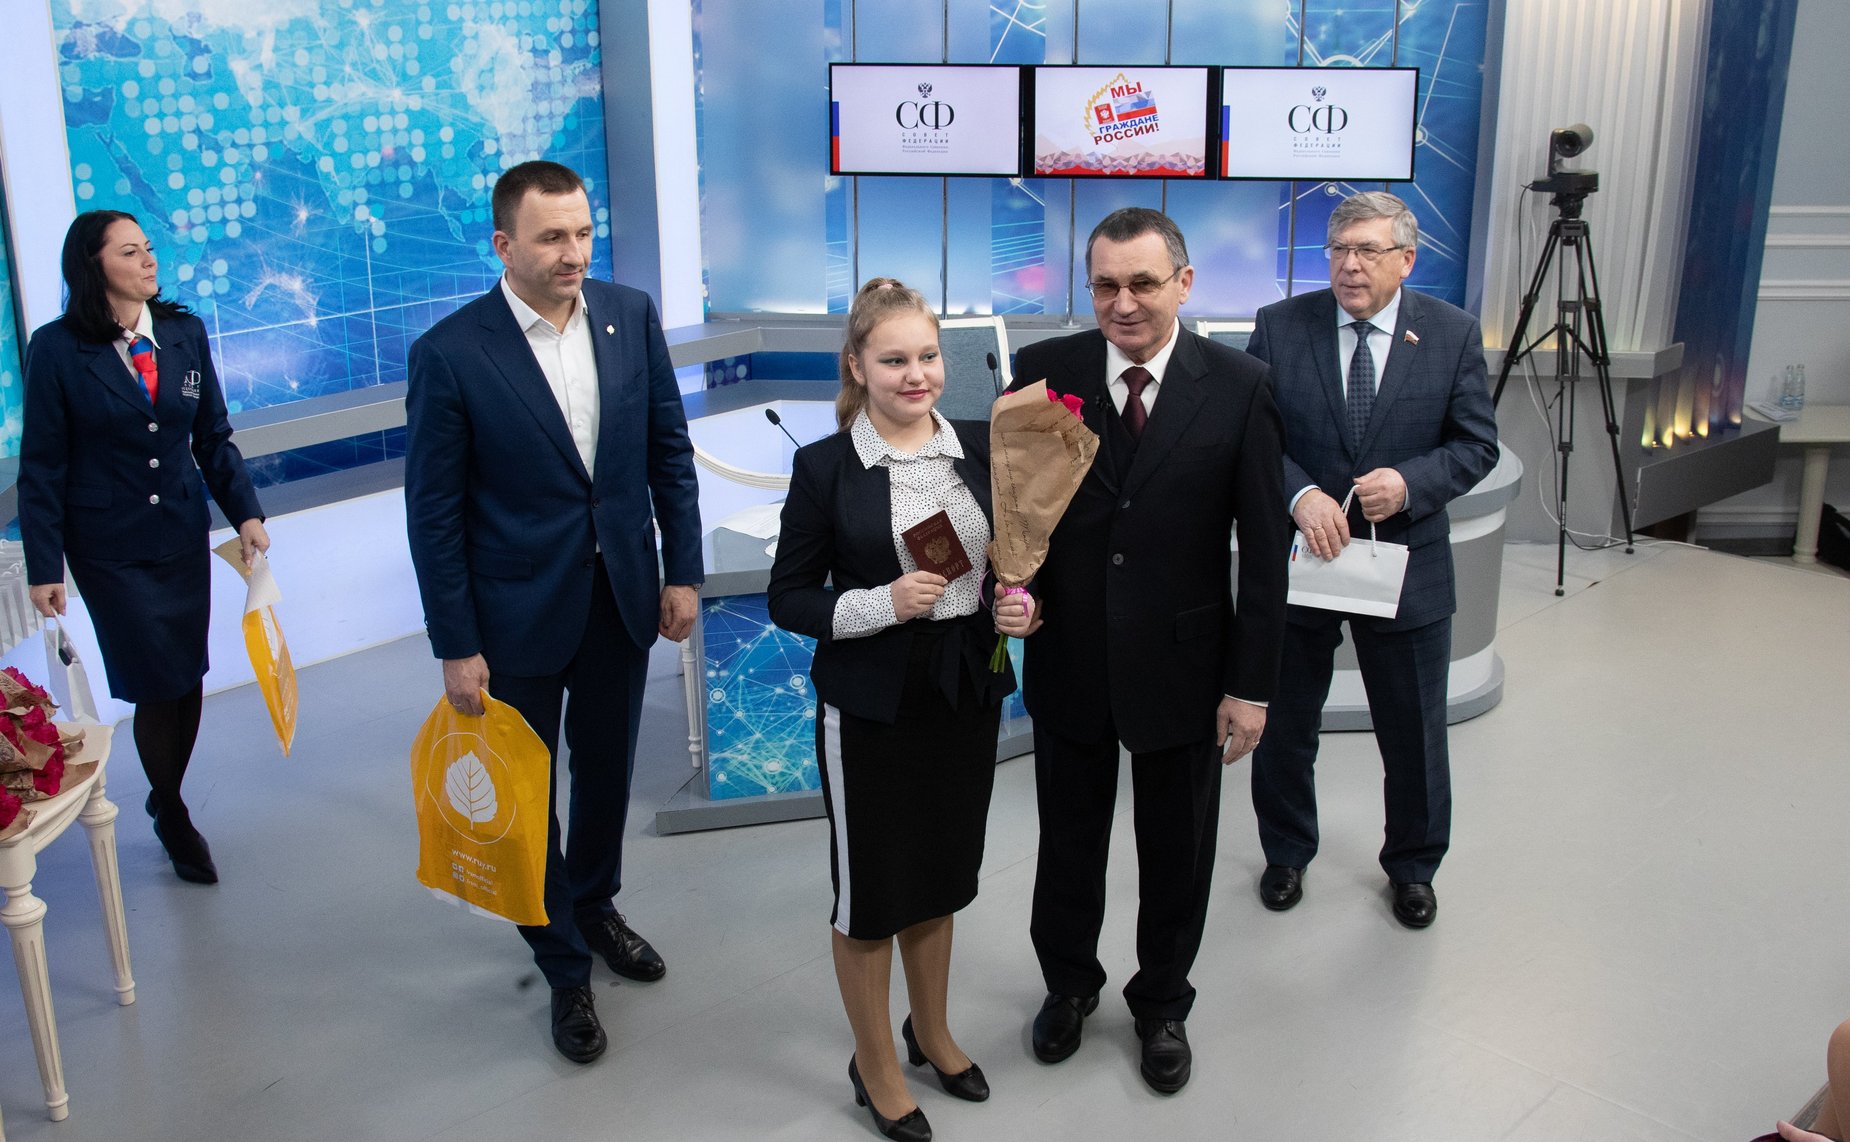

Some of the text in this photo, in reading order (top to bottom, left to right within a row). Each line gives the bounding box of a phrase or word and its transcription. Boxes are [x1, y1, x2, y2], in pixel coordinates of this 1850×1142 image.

[1110, 81, 1142, 98] МЫ
[896, 100, 955, 130] СФ
[1099, 114, 1159, 134] ГРАЖДАНЕ
[1288, 104, 1348, 134] СФ
[1094, 122, 1160, 145] РОССИИ!
[184, 370, 200, 385] Ф
[939, 560, 965, 577] СПОРТ
